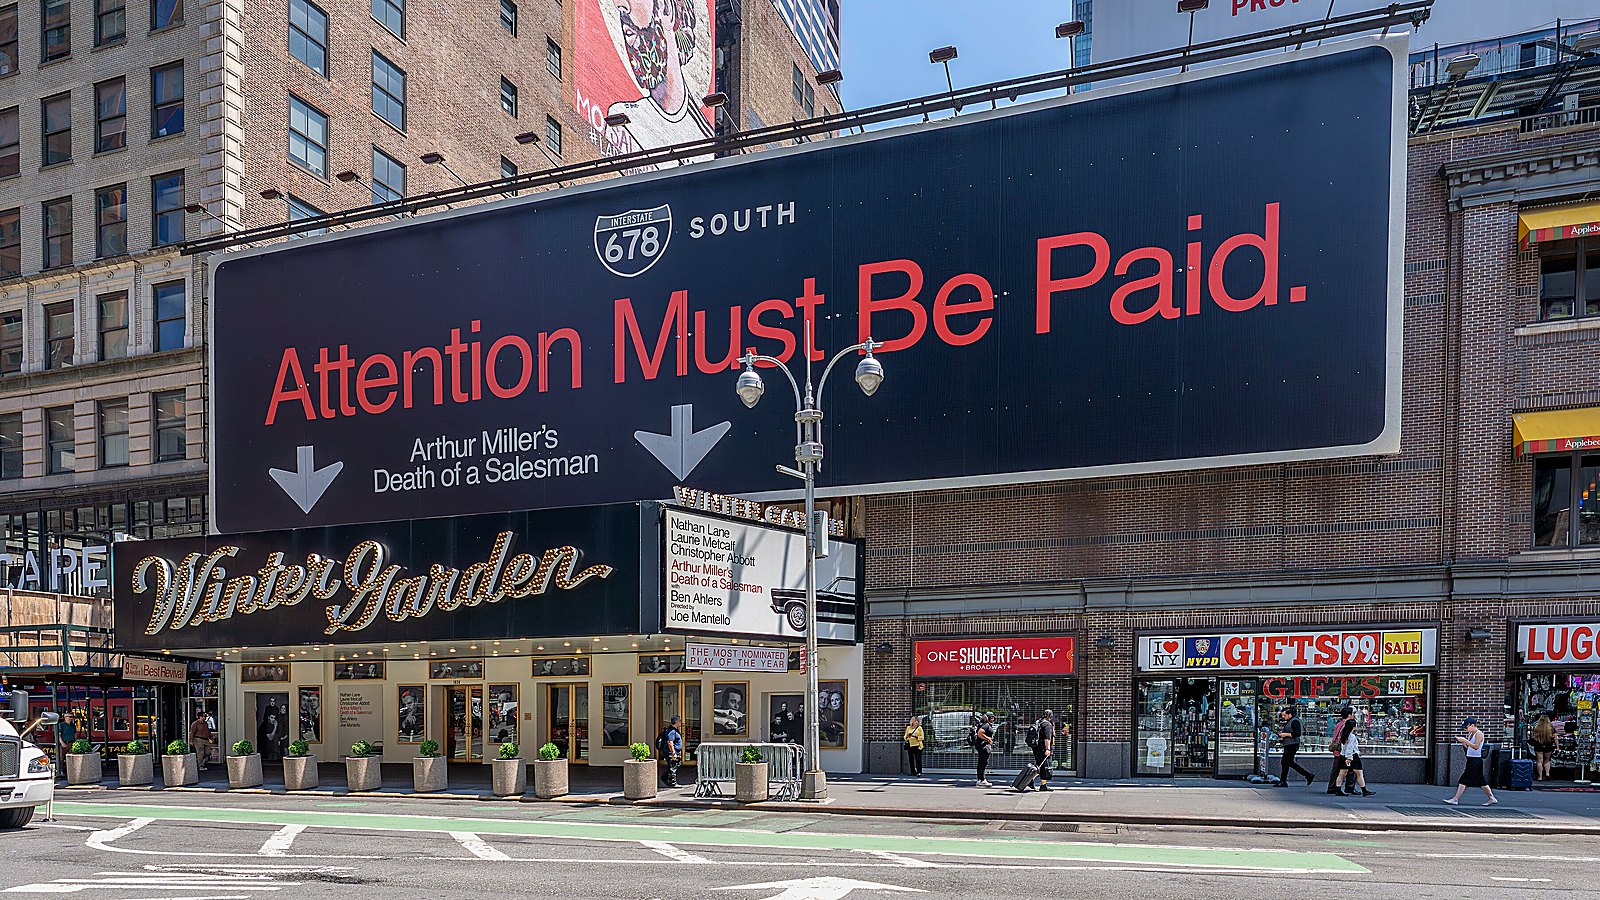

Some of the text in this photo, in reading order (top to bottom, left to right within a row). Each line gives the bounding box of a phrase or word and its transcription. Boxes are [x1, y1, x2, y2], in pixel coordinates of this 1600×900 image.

[610, 211, 653, 226] INTERSTATE
[604, 201, 796, 263] 678 SOUTH
[265, 202, 1307, 426] Attention Must Be Paid.
[410, 433, 476, 463] Arthur
[373, 450, 599, 493] Death of a Salesman
[673, 485, 761, 521] WINTER
[671, 517, 730, 538] Nathan Lane
[671, 530, 736, 551] Laurie Metcalf
[671, 543, 755, 567] Christopher Abbott
[671, 559, 700, 574] Arthur
[132, 530, 614, 636] Winter Garden
[671, 572, 763, 594] Death of a Salesman
[671, 590, 723, 607] Ben Ahlers
[671, 610, 731, 626] Joe Mantello
[1154, 641, 1163, 654] I
[1224, 634, 1340, 666] GIFTS
[1384, 641, 1420, 655] SALE
[1527, 626, 1600, 661] LUG
[690, 657, 785, 669] PLAY OF THE YEAR
[691, 648, 785, 660] THE MOST NOMINATED
[927, 646, 1058, 664] ONE SHUBERT ALLEY
[1153, 654, 1180, 666] NY
[1186, 657, 1219, 667] NYPD
[144, 664, 185, 679] Best Revival
[1263, 676, 1380, 699] GIFTS
[1408, 682, 1421, 691] SALE
